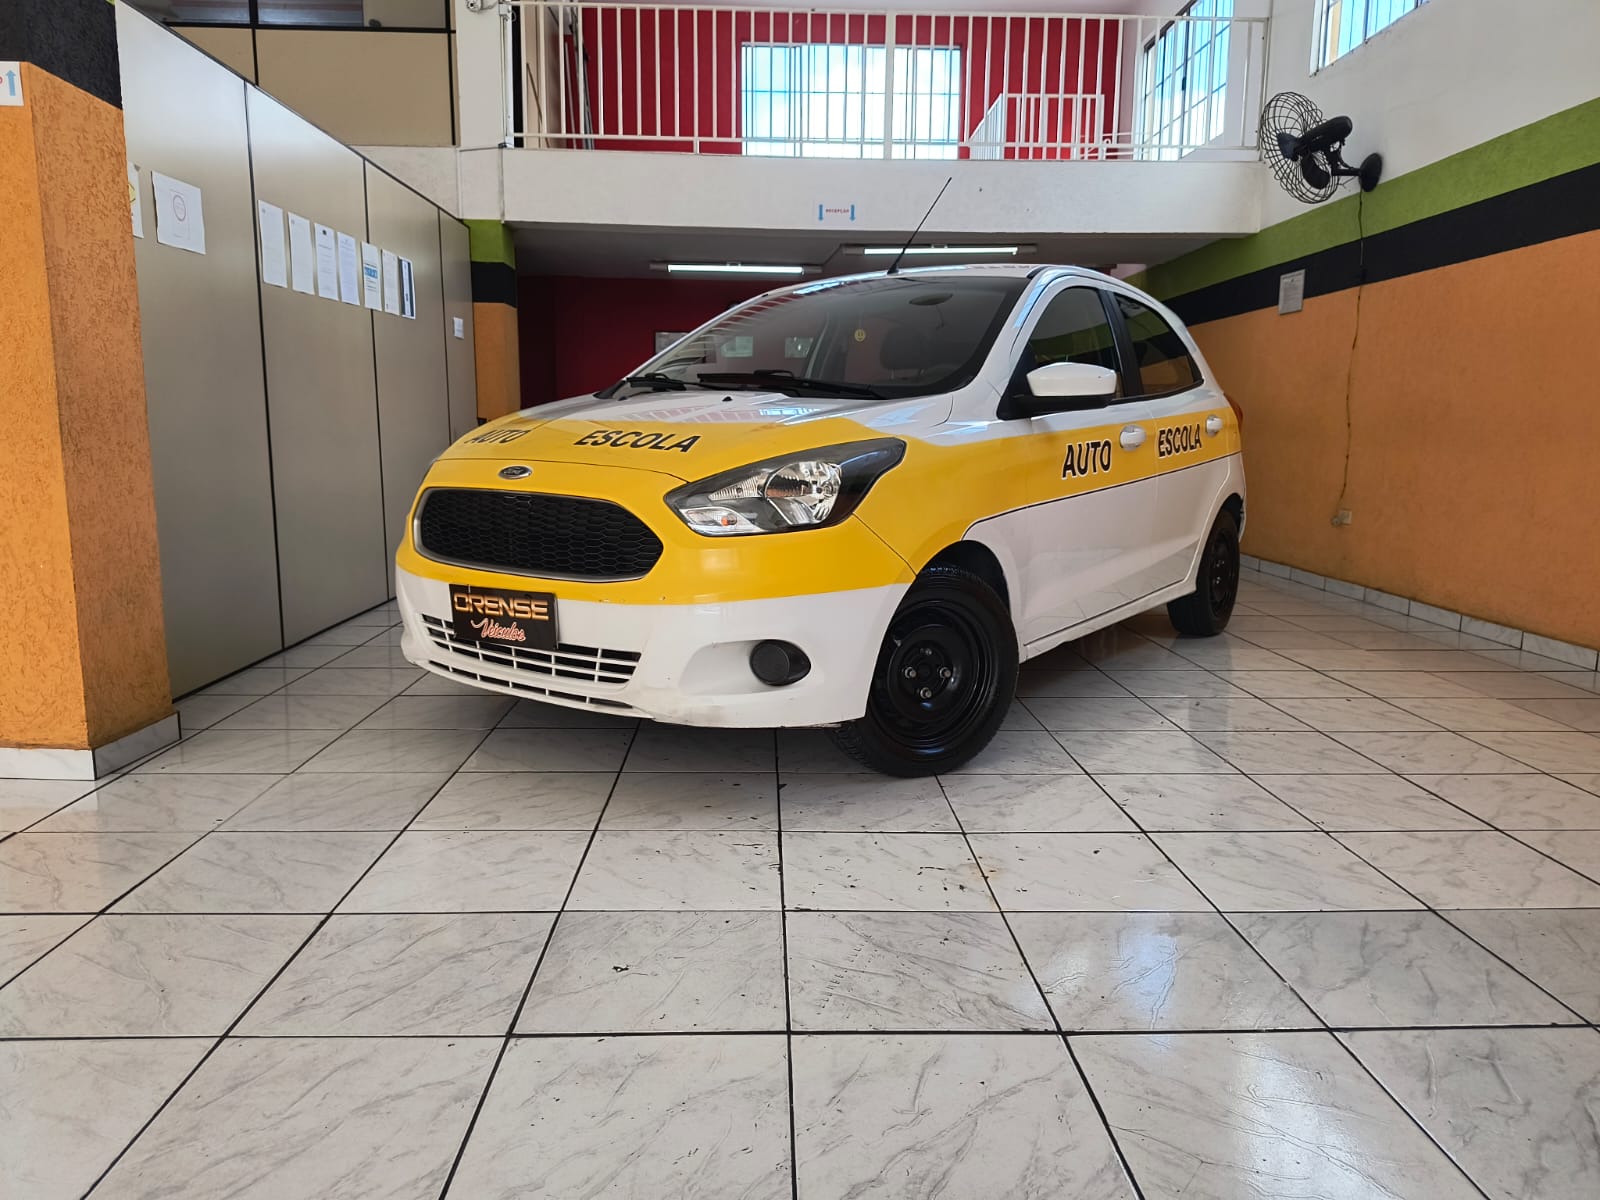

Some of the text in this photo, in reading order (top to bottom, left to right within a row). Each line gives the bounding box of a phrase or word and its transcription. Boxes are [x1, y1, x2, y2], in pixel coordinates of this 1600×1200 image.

[463, 429, 702, 453] AUTO ESCOLA
[1062, 424, 1202, 478] AUTO ESCOLA
[453, 592, 550, 621] ORENSE
